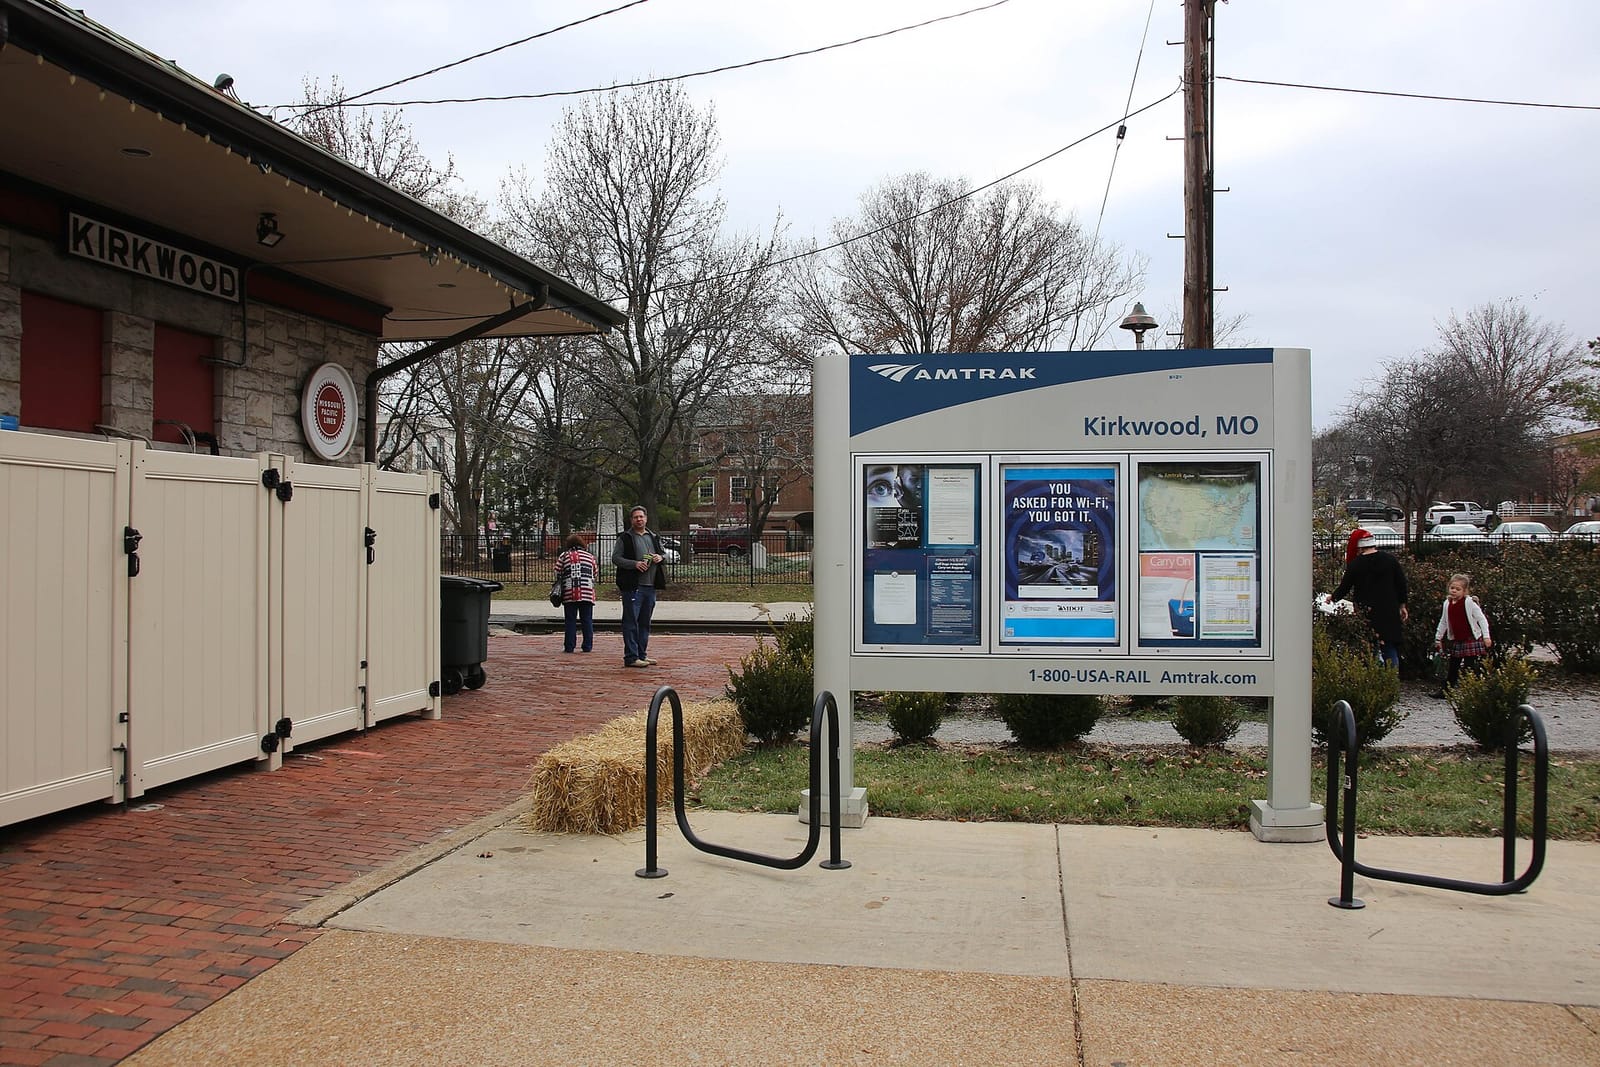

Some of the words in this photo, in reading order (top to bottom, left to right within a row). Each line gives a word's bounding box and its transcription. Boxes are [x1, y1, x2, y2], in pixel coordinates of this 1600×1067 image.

[72, 216, 236, 297] KIRKWOOD
[914, 367, 1037, 381] AMTRAK
[319, 400, 341, 409] MISSOURI
[321, 408, 338, 417] PACIFIC
[323, 417, 337, 425] LINES
[1084, 415, 1207, 438] Kirkwood,
[1216, 415, 1259, 436] MO
[1049, 483, 1071, 495] YOU
[1013, 497, 1047, 508] ASKED
[1051, 497, 1073, 508] FOR
[897, 512, 918, 524] SEE
[1029, 511, 1050, 522] YOU
[1054, 511, 1076, 522] GOT
[1079, 511, 1092, 522] IT.
[897, 526, 919, 537] SAY
[1150, 556, 1175, 569] Carry
[1176, 556, 1191, 567] On
[1029, 669, 1150, 684] 1-800-USA-RAIL
[1160, 670, 1257, 685] Amtrak.com
